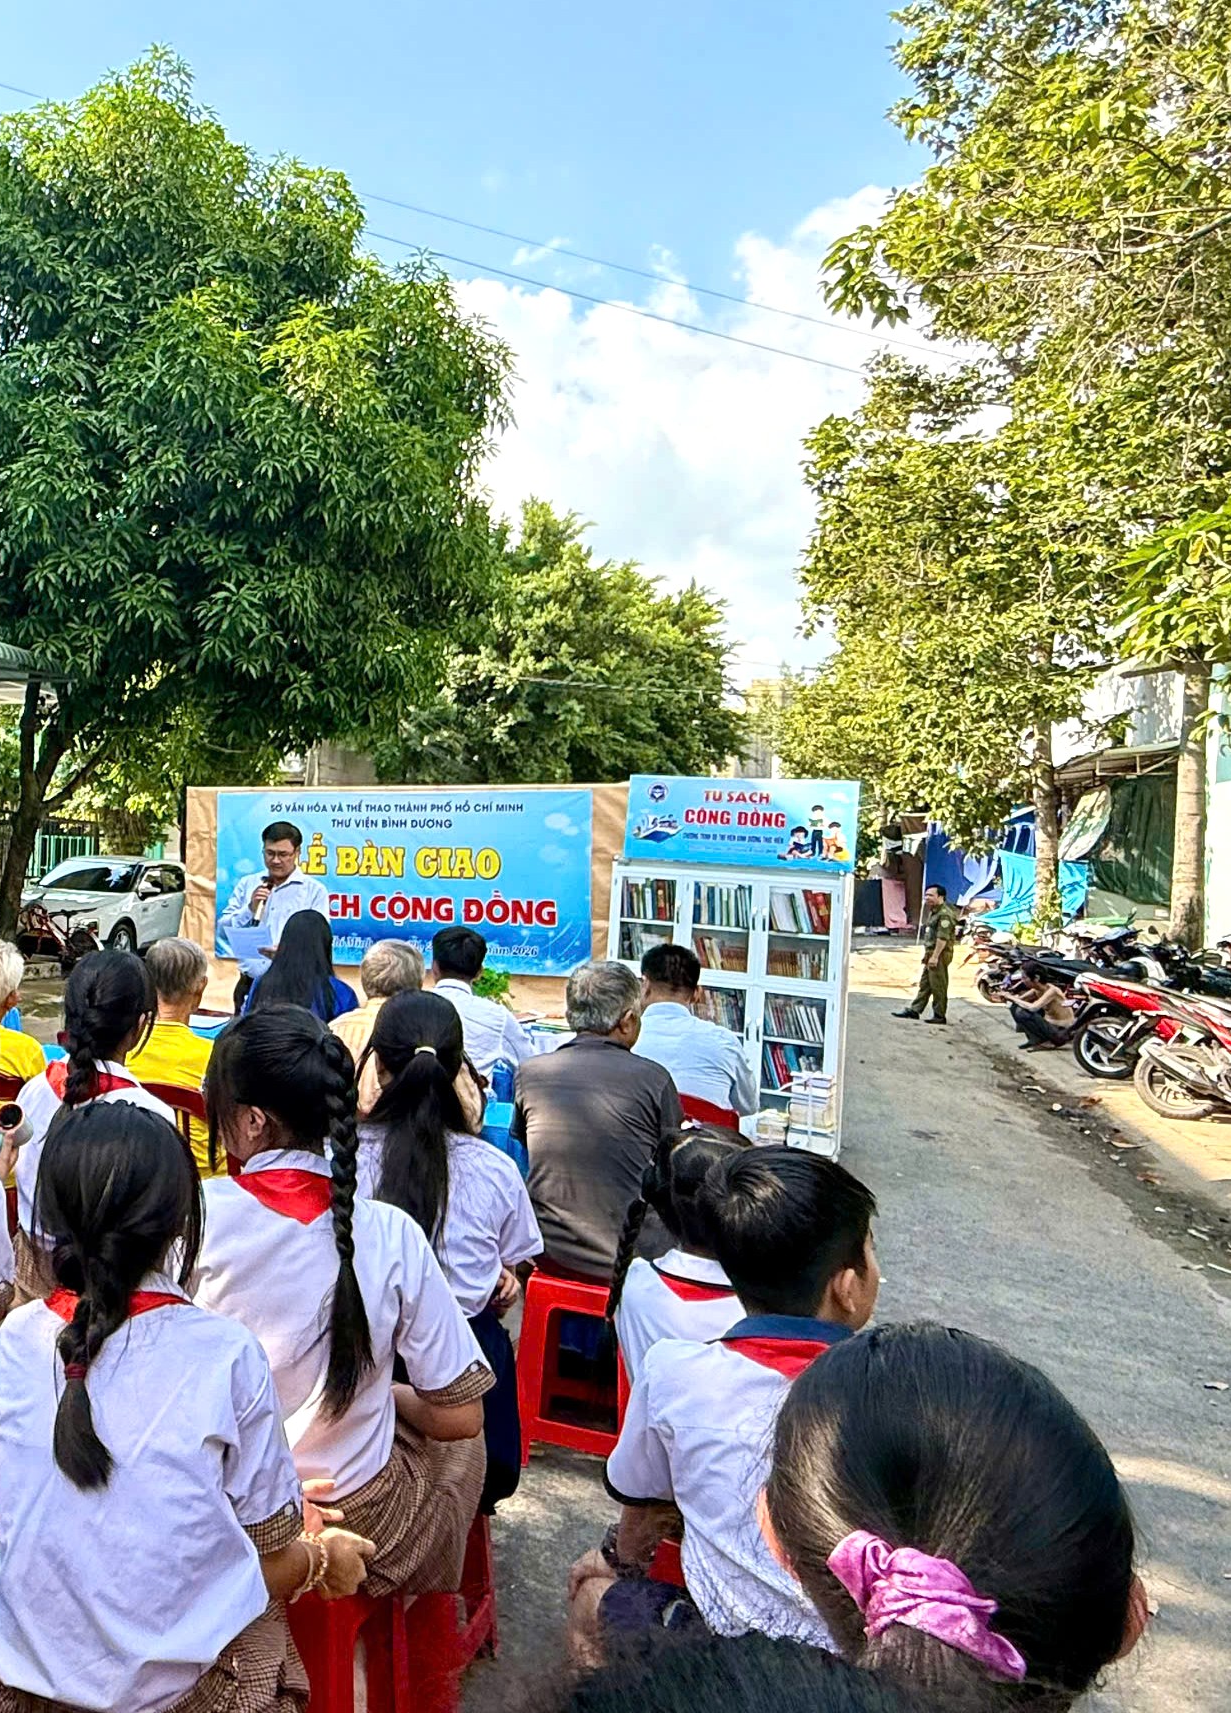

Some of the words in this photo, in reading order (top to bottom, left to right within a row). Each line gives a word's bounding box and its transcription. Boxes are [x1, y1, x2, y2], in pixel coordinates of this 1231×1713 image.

[285, 802, 304, 812] VĂN
[307, 802, 328, 813] HÓA
[330, 801, 343, 812] VÀ
[365, 803, 391, 813] THAO
[394, 802, 427, 813] THÀNH
[430, 801, 452, 812] PHỐ
[473, 802, 492, 812] CHÍ
[495, 803, 524, 812] MINH
[331, 817, 352, 828] THƯ
[355, 817, 378, 831] VIỆN
[381, 817, 407, 829] BÌNH
[410, 817, 453, 829] DƯƠNG
[336, 838, 405, 878] BÀN
[414, 846, 501, 880] GIAO
[329, 894, 360, 917] CH
[370, 891, 453, 925] CỘNG
[464, 890, 556, 926] ĐỒNG
[512, 946, 538, 957] 2026
